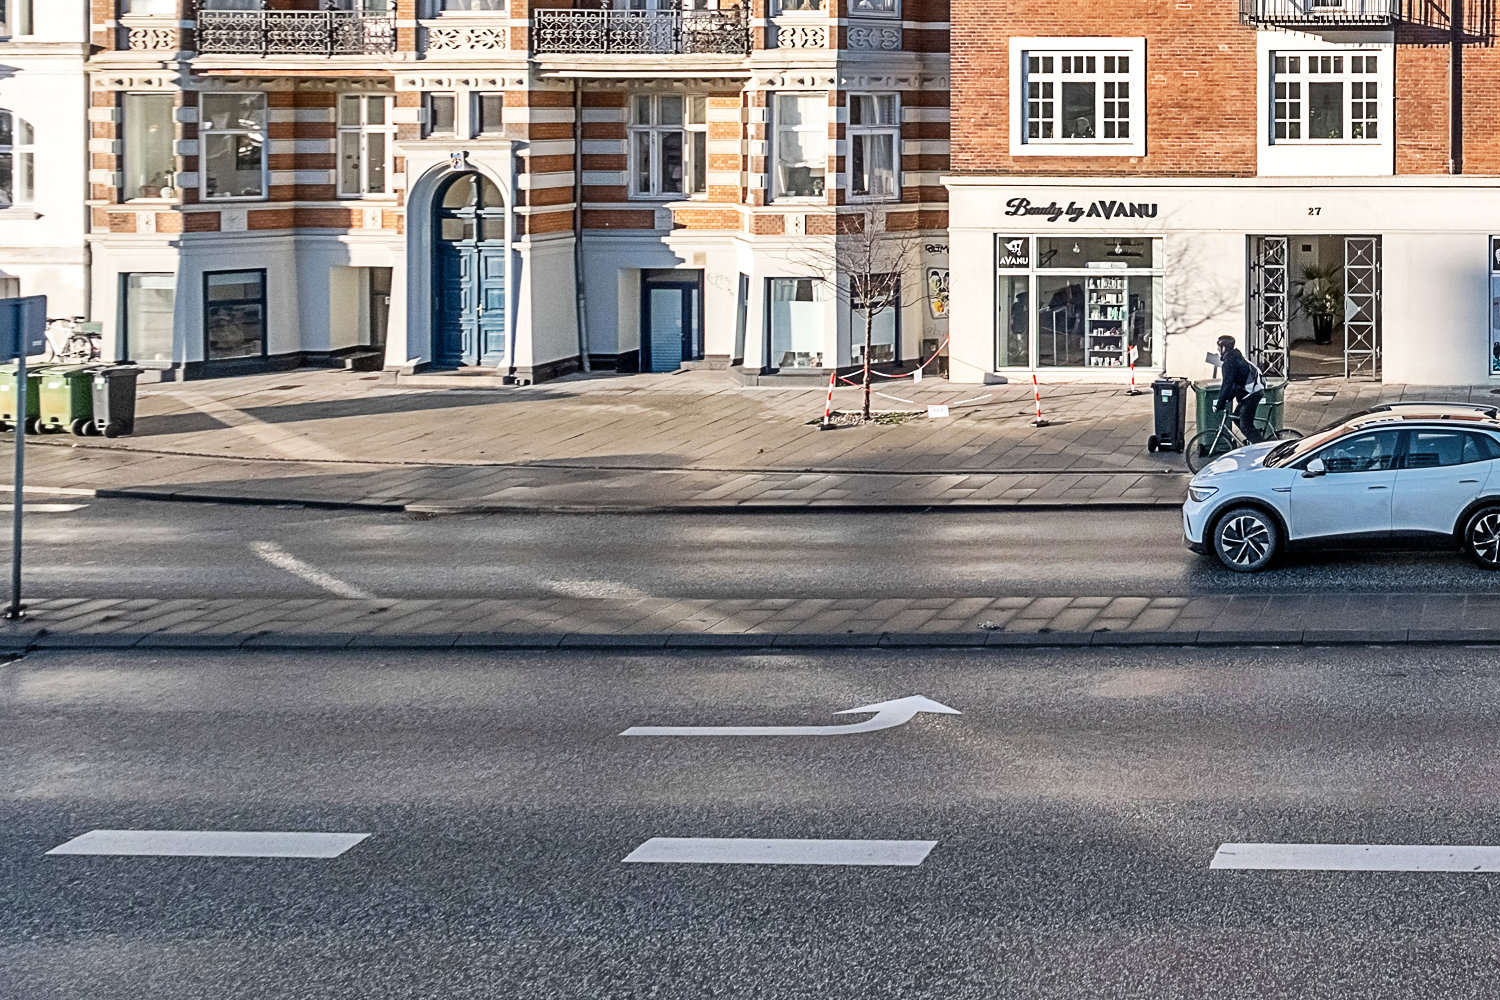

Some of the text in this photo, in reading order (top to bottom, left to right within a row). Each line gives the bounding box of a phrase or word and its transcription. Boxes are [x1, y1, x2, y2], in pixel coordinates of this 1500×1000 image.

[1005, 198, 1158, 222] Beauty by AVANU
[1308, 207, 1321, 215] 27
[1000, 256, 1028, 265] AVANU
